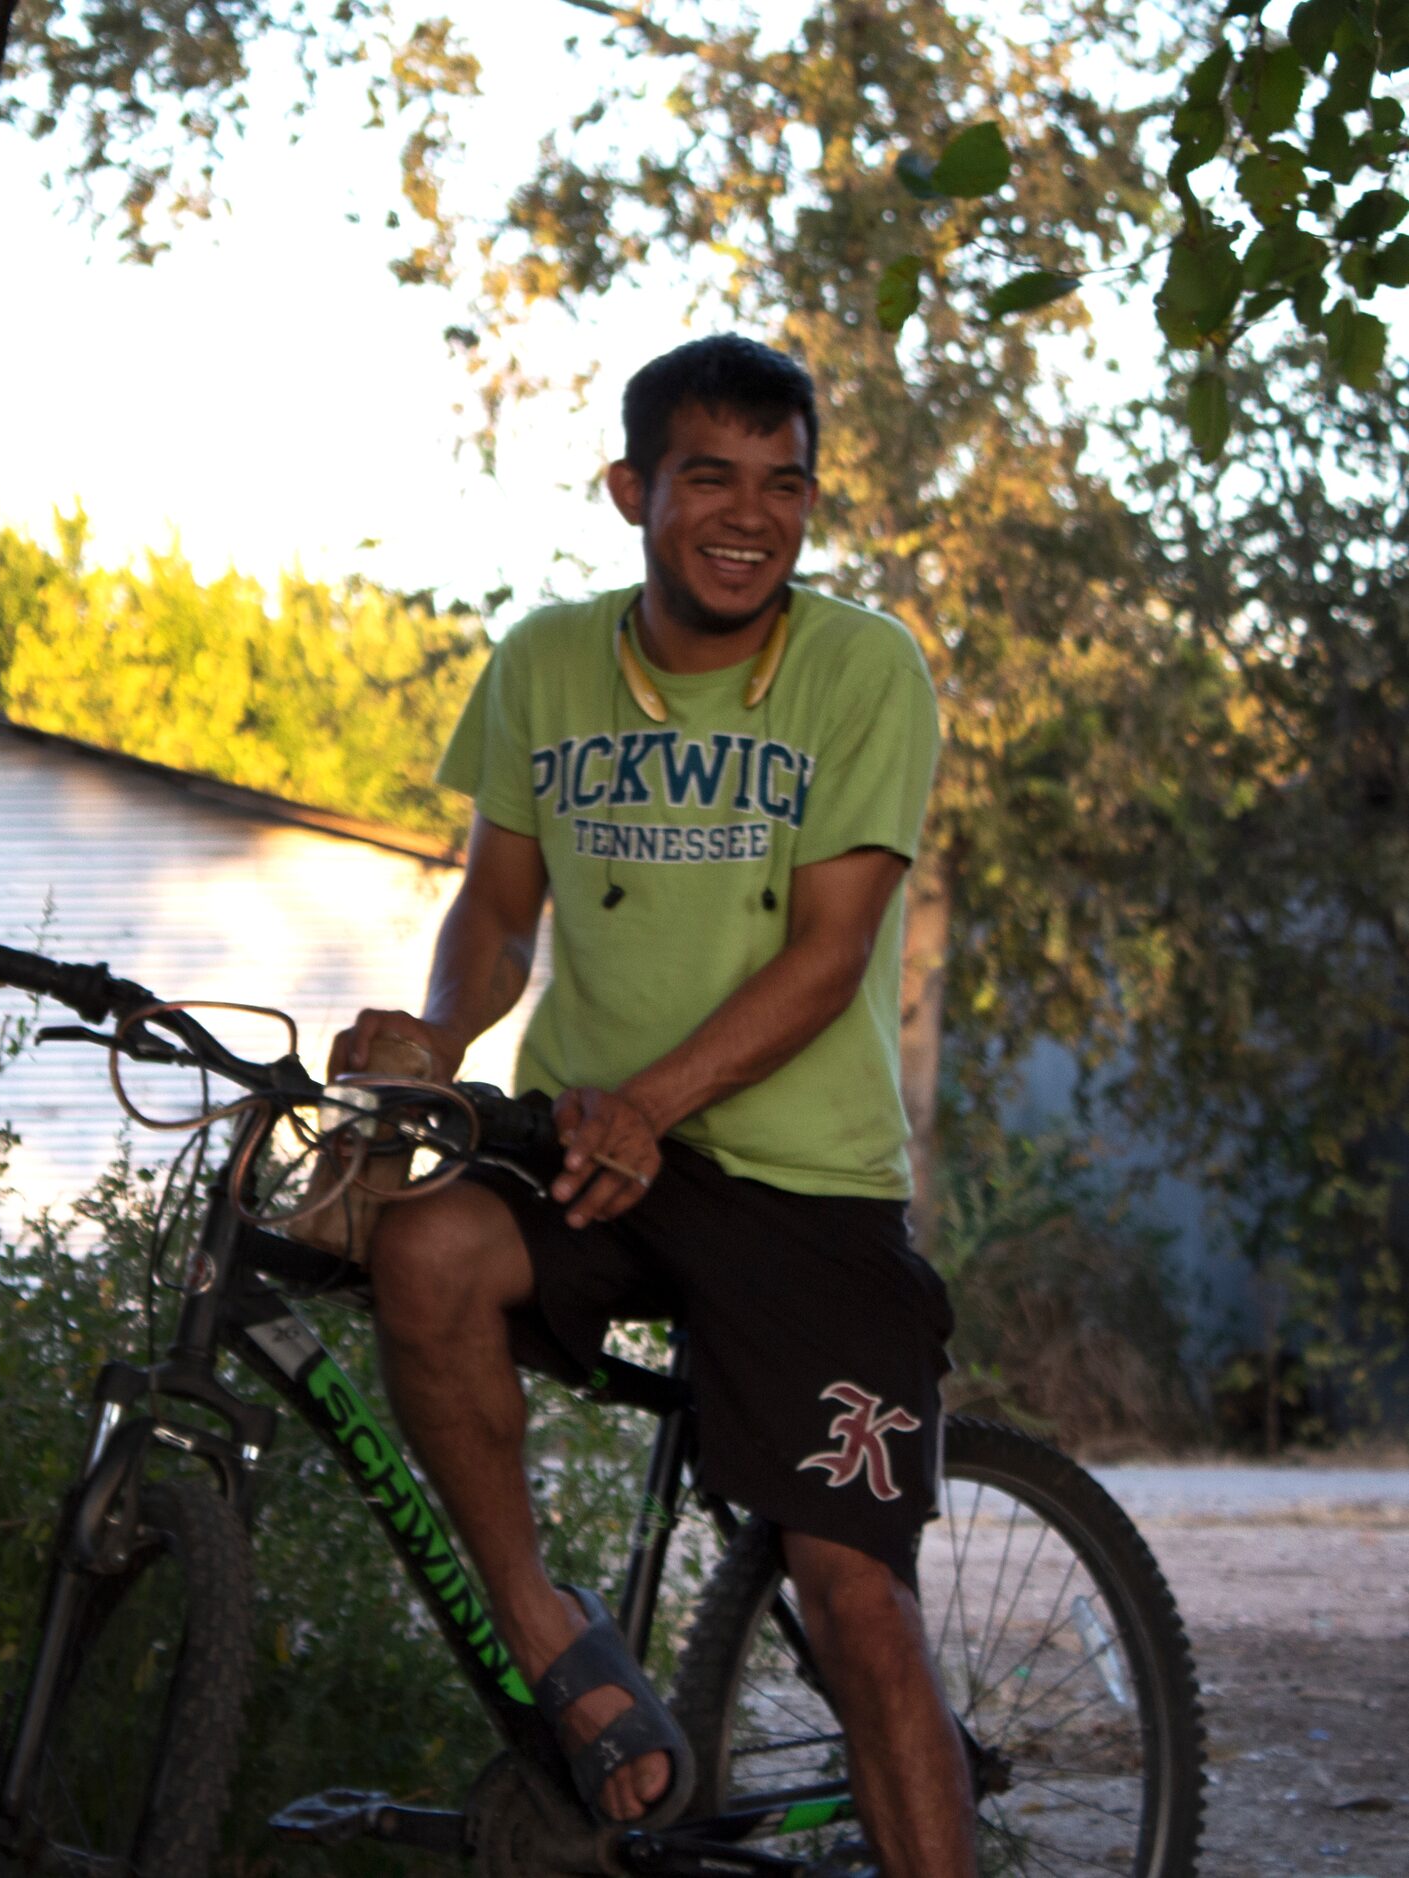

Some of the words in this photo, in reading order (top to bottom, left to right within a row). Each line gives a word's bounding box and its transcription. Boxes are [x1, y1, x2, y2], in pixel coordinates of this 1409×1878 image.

[573, 818, 771, 863] TENNESSEE
[796, 1381, 922, 1501] K
[321, 1379, 514, 1680] SCHWINN
